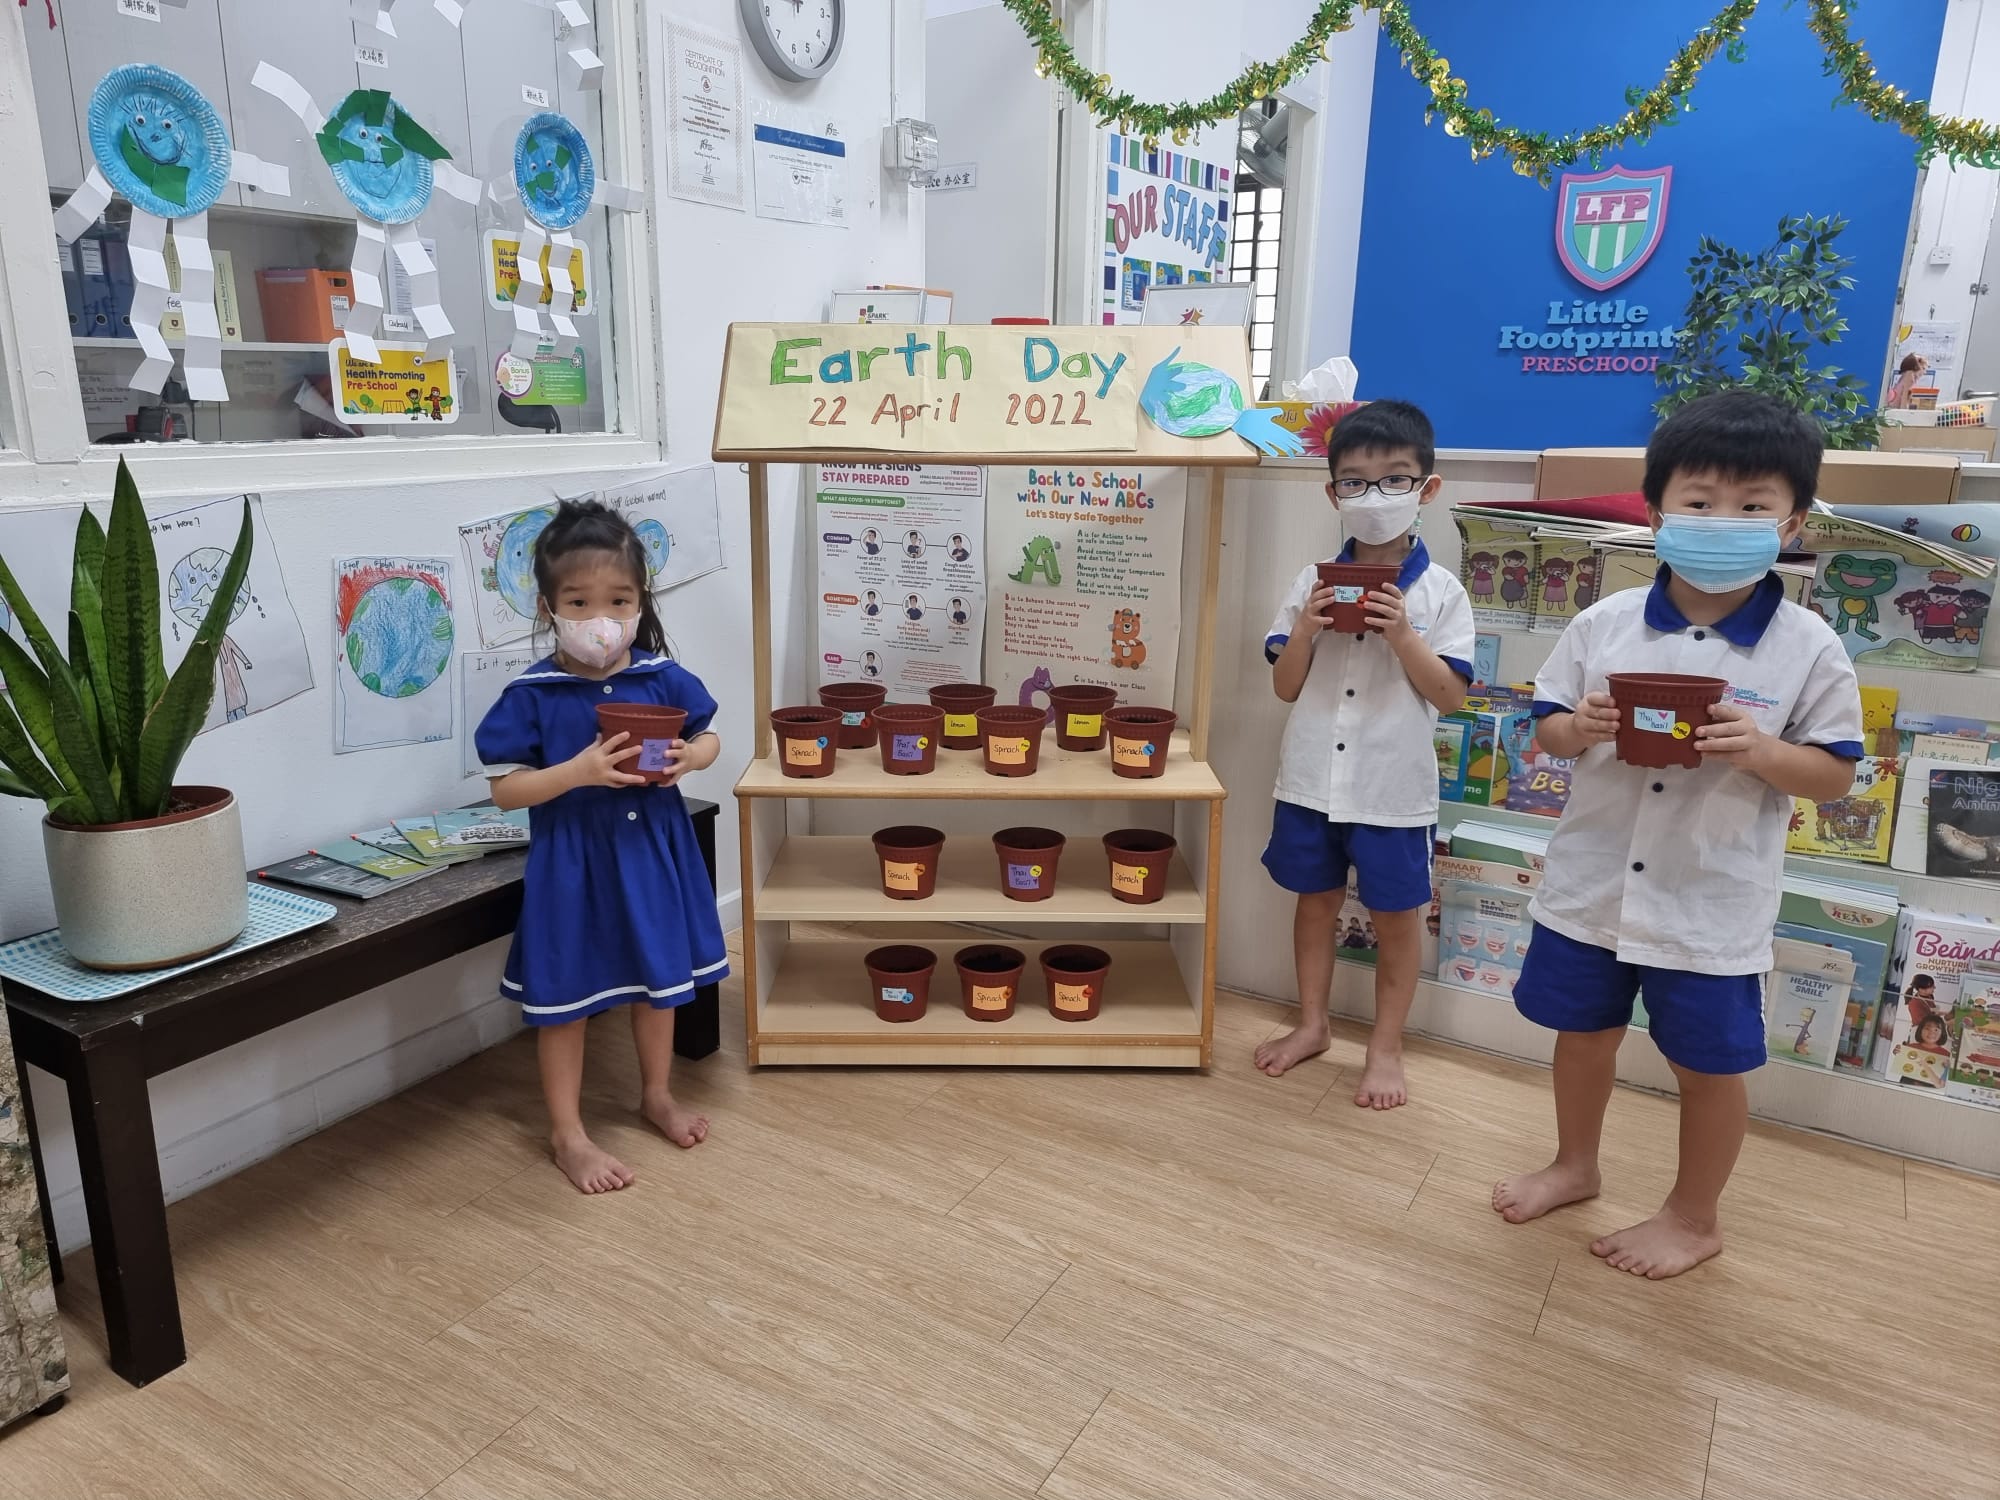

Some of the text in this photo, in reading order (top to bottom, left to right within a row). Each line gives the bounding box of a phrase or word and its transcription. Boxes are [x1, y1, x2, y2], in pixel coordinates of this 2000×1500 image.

[766, 6, 769, 16] 8
[820, 8, 824, 18] 3
[776, 29, 780, 39] 7
[816, 29, 820, 39] 4
[792, 44, 796, 53] 6
[805, 43, 810, 53] 5
[945, 173, 970, 185] 办公室
[1576, 195, 1649, 221] LFP
[1114, 184, 1226, 268] OUR STAFF
[499, 259, 518, 267] Heal
[1548, 300, 1648, 324] Little
[770, 331, 1126, 399] Earth Day
[346, 370, 425, 382] Health Promoting
[348, 381, 397, 391] Pre-School
[809, 391, 1092, 438] 22 April 2022
[822, 472, 849, 482] STAY
[853, 474, 909, 486] PREPARED
[1029, 469, 1141, 489] Back to School
[1017, 489, 1154, 508] with Our New ABCs
[1026, 510, 1144, 525] Let's Stay Safe Together
[477, 658, 487, 670] Is
[505, 658, 532, 672] gettin
[792, 747, 817, 761] Spinach
[994, 745, 1019, 755] Spinach
[1117, 745, 1143, 757] Spinach
[1436, 859, 1482, 873] PRIMARY
[888, 870, 910, 880] Spinach
[1115, 873, 1138, 884] Spinach
[1916, 963, 1955, 974] GROWTH
[1928, 958, 1969, 969] NURTURI
[1790, 976, 1832, 991] HEALTHY
[1795, 985, 1824, 997] SMILE
